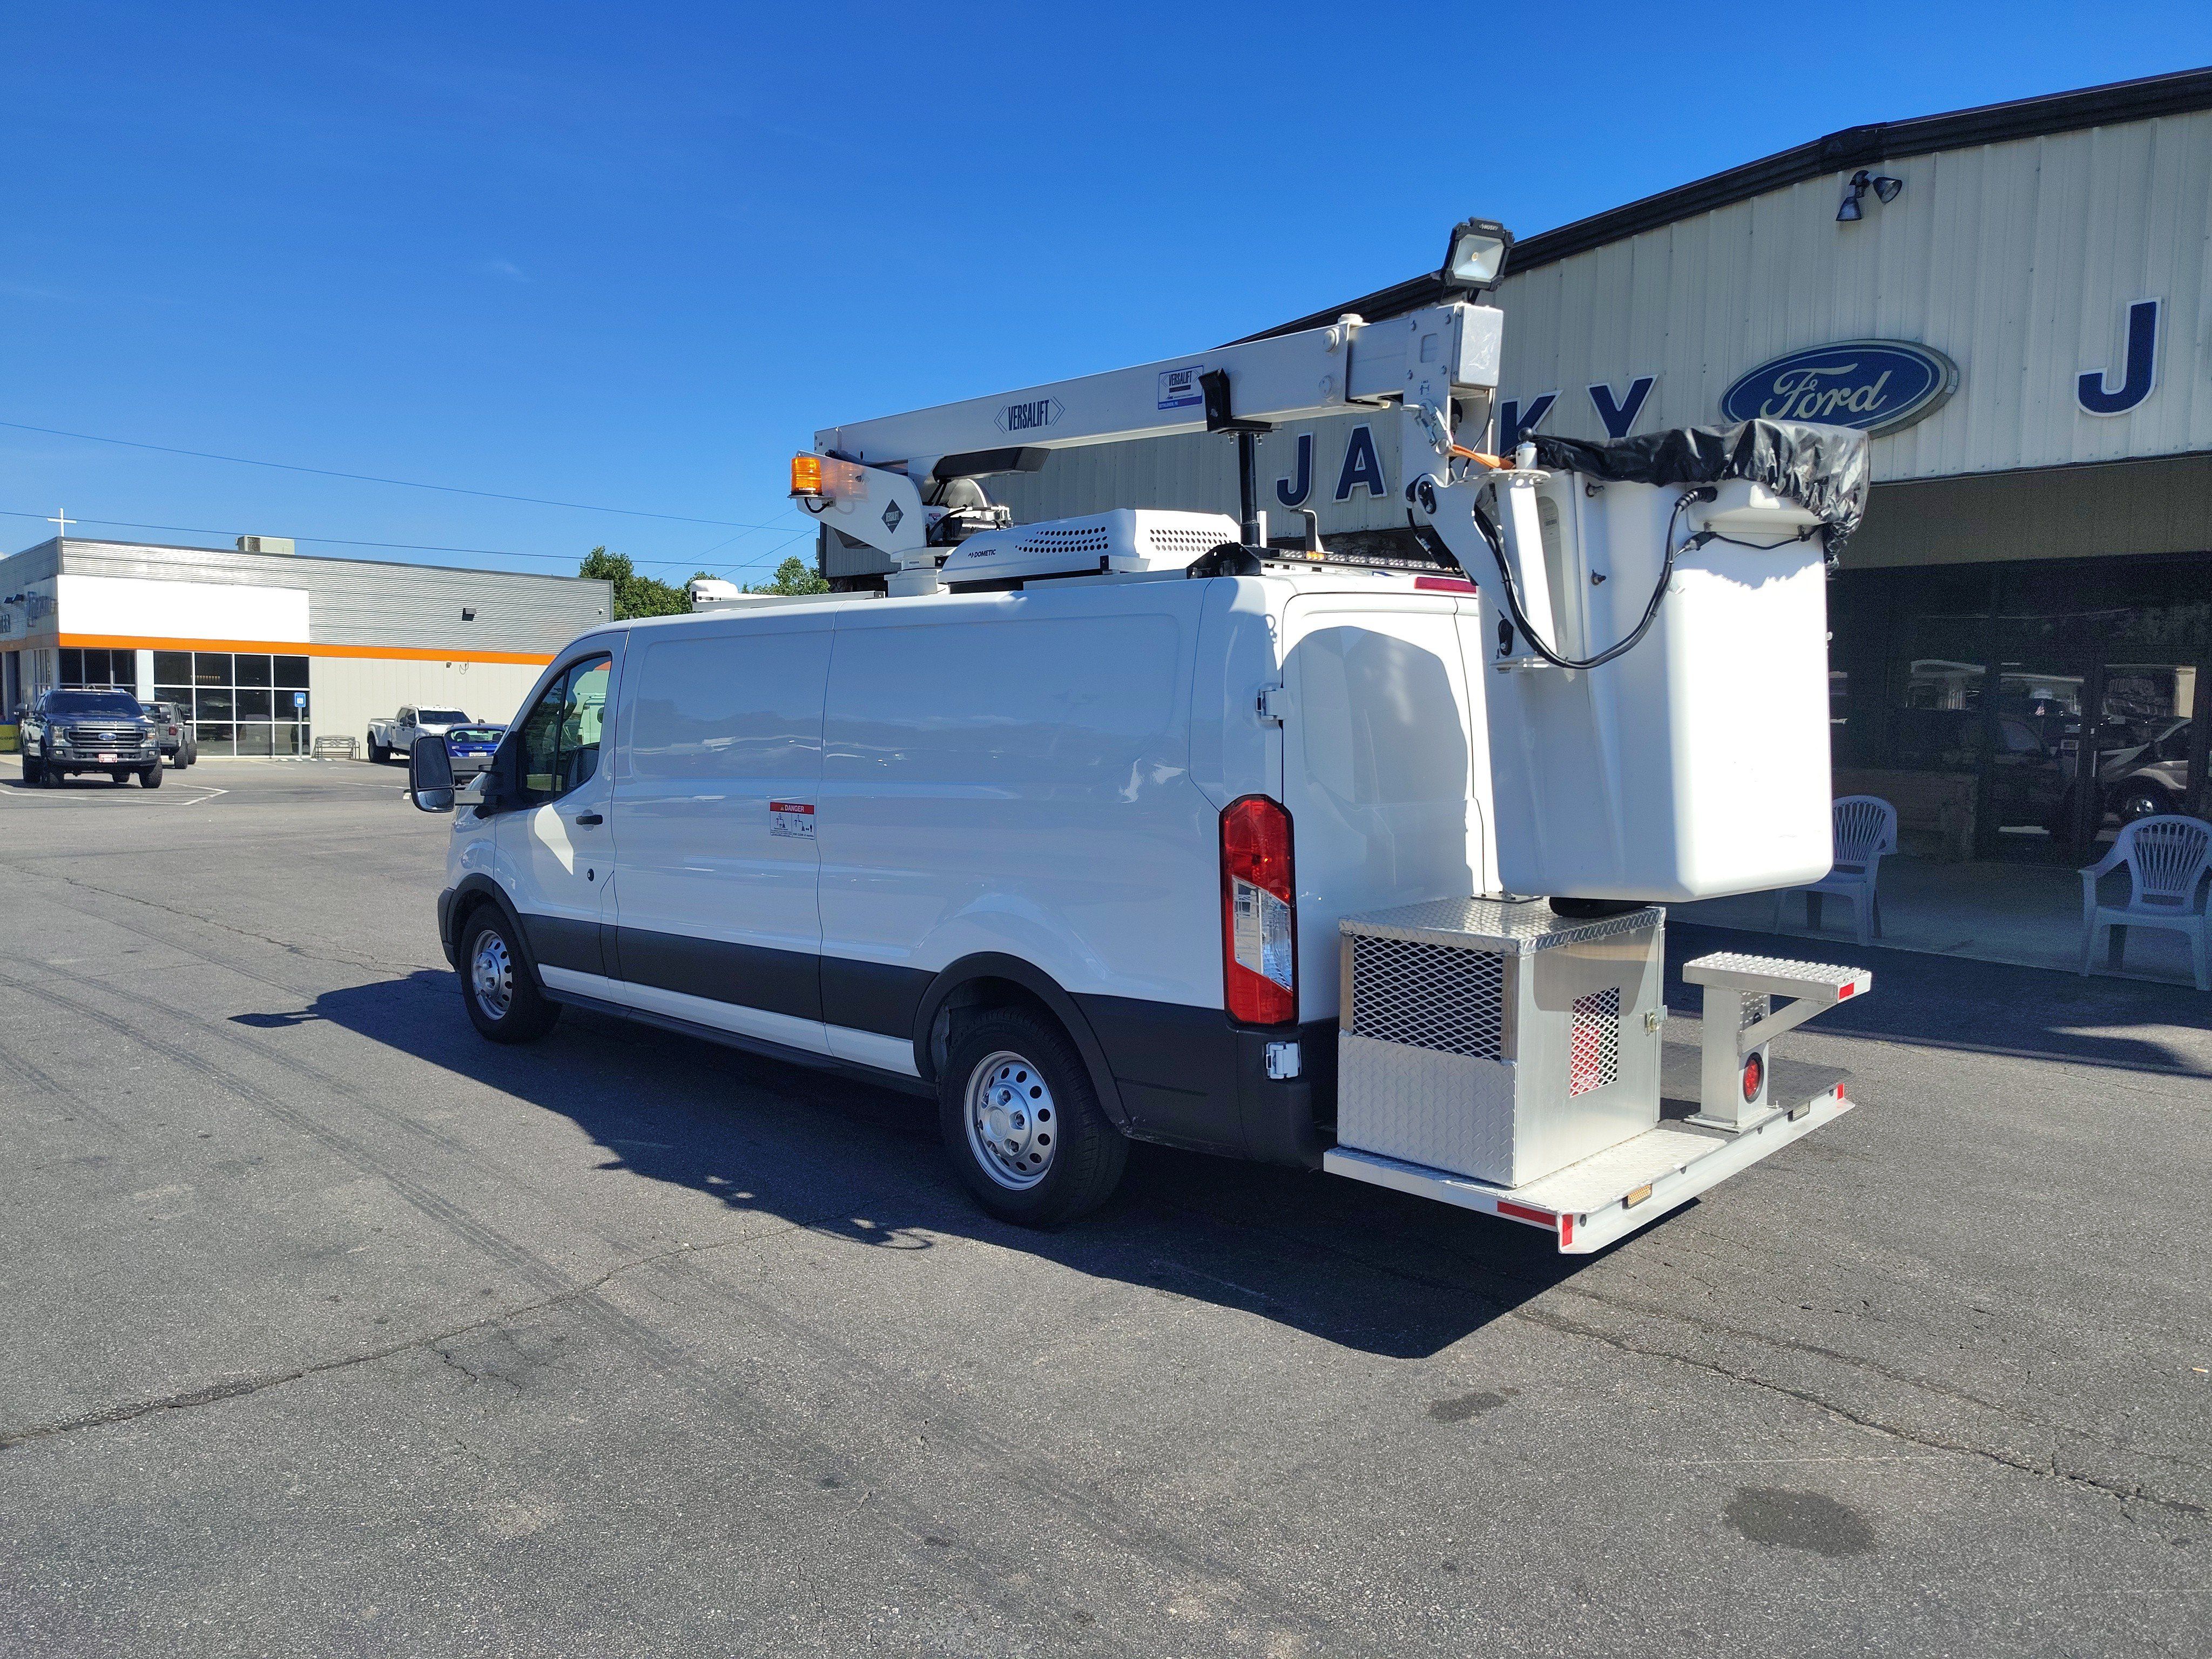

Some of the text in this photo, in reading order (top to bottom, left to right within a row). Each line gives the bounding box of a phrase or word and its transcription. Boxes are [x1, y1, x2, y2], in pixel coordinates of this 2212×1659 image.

[1169, 370, 1192, 387] VERSALIFT
[1759, 363, 1893, 420] Ford
[1008, 399, 1049, 431] VERSALIFT
[1276, 374, 1658, 509] JAKY
[974, 549, 996, 558] DOMETIC
[785, 804, 805, 812] DANGER
